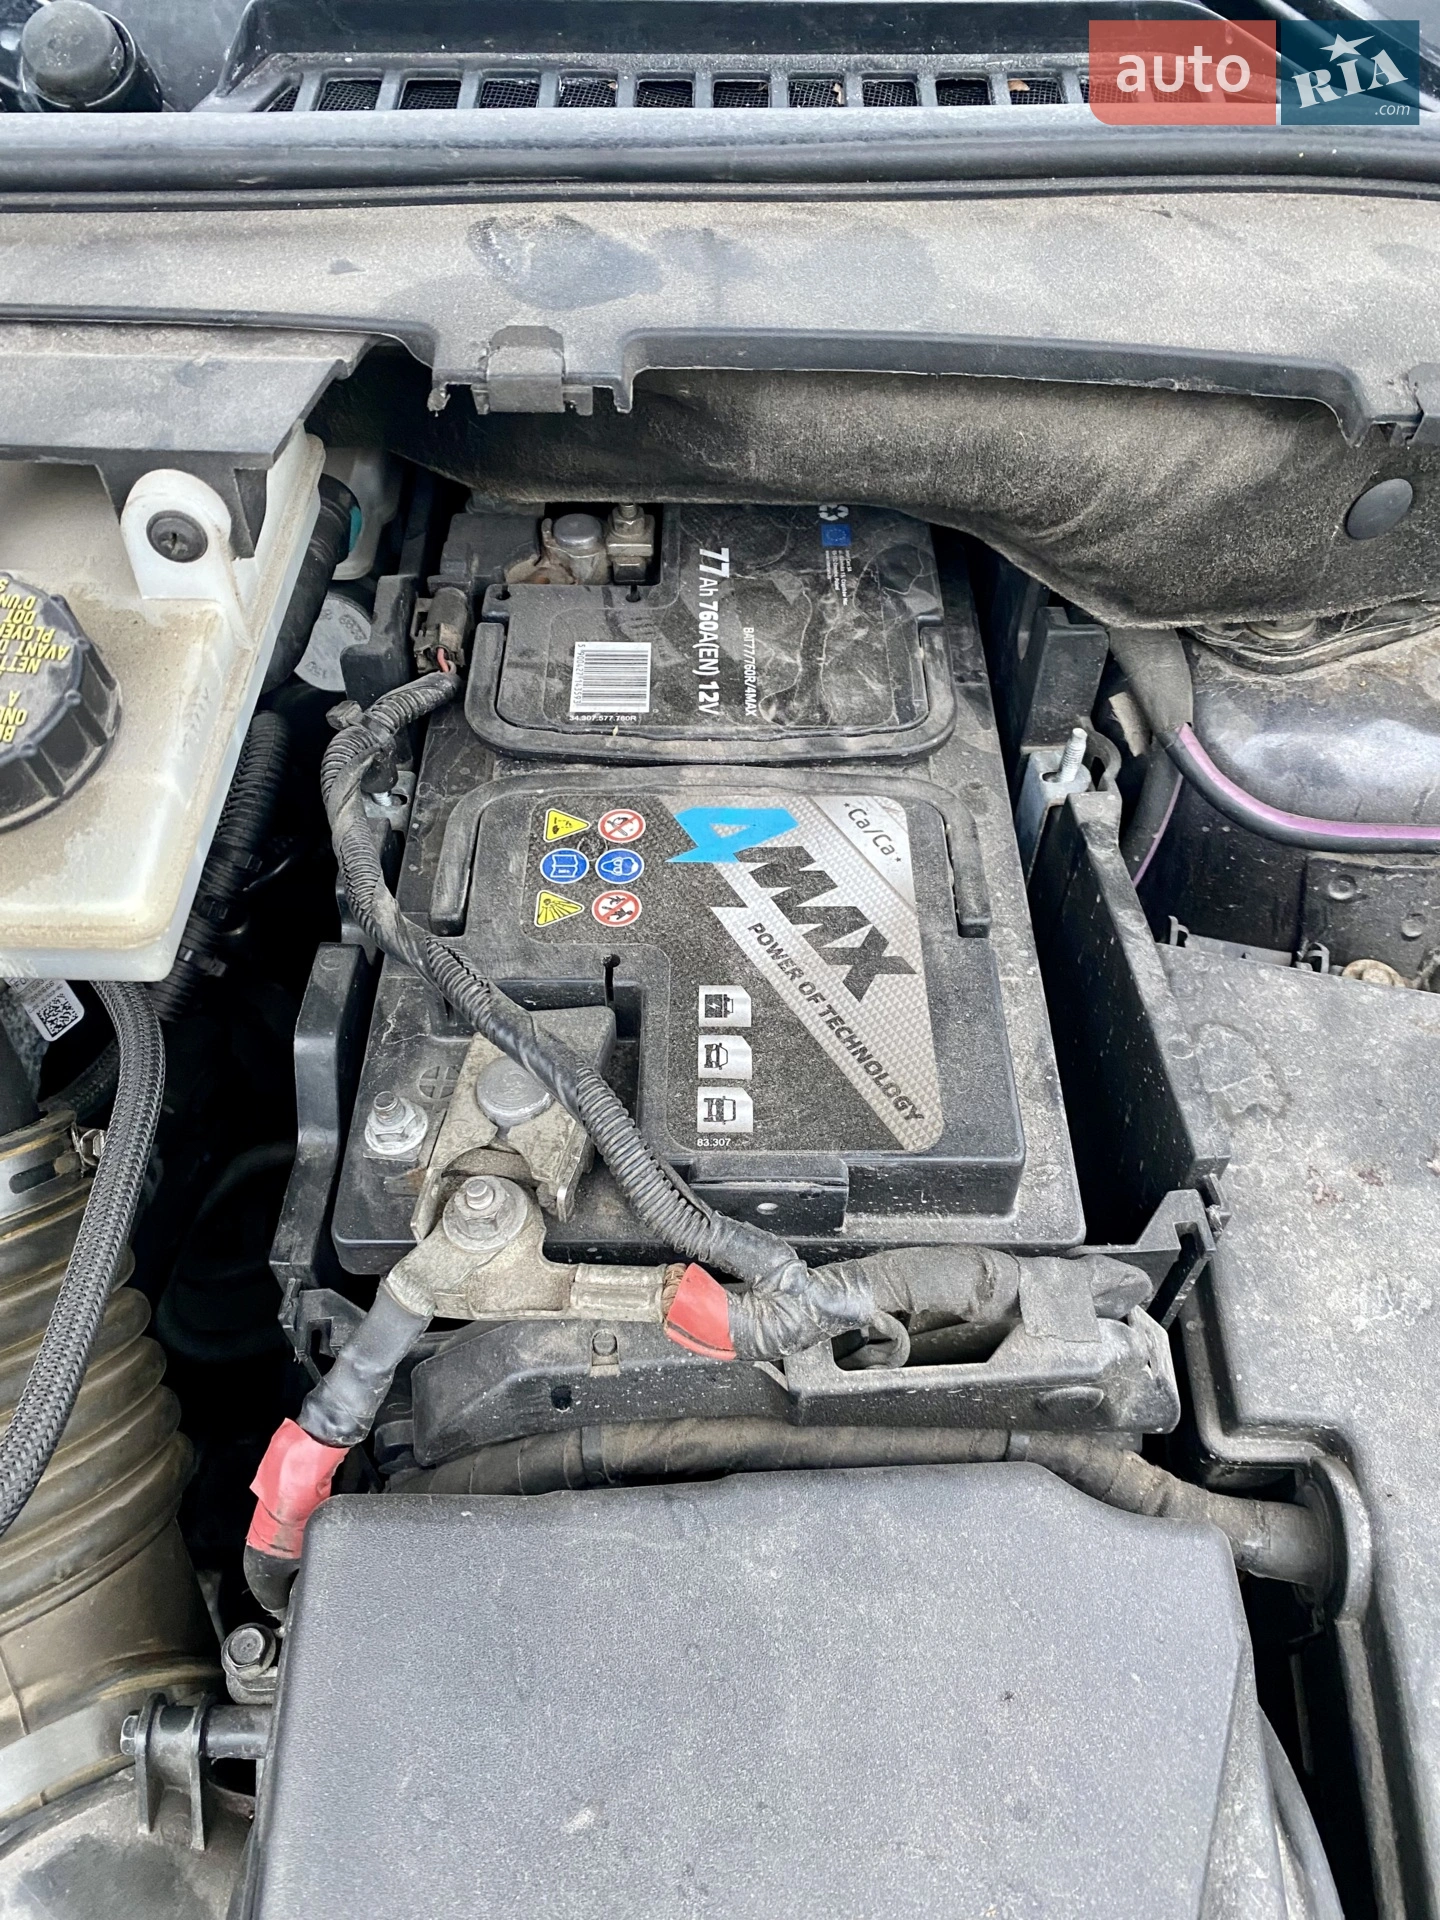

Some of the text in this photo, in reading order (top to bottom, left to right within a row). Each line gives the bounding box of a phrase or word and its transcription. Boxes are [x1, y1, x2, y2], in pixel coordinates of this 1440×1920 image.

[4, 608, 37, 626] DOT
[692, 600, 721, 676] 760A(EN)
[15, 641, 70, 661] AVANT
[743, 626, 757, 717] BAT77/760R/4MAX
[9, 690, 21, 708] A
[698, 681, 720, 716] 12V
[848, 807, 896, 857] Ca/Ca
[664, 807, 918, 1003] 4MAX
[748, 922, 925, 1121] POWER OF TECHNOLOGY
[696, 1138, 732, 1147] 83.307
